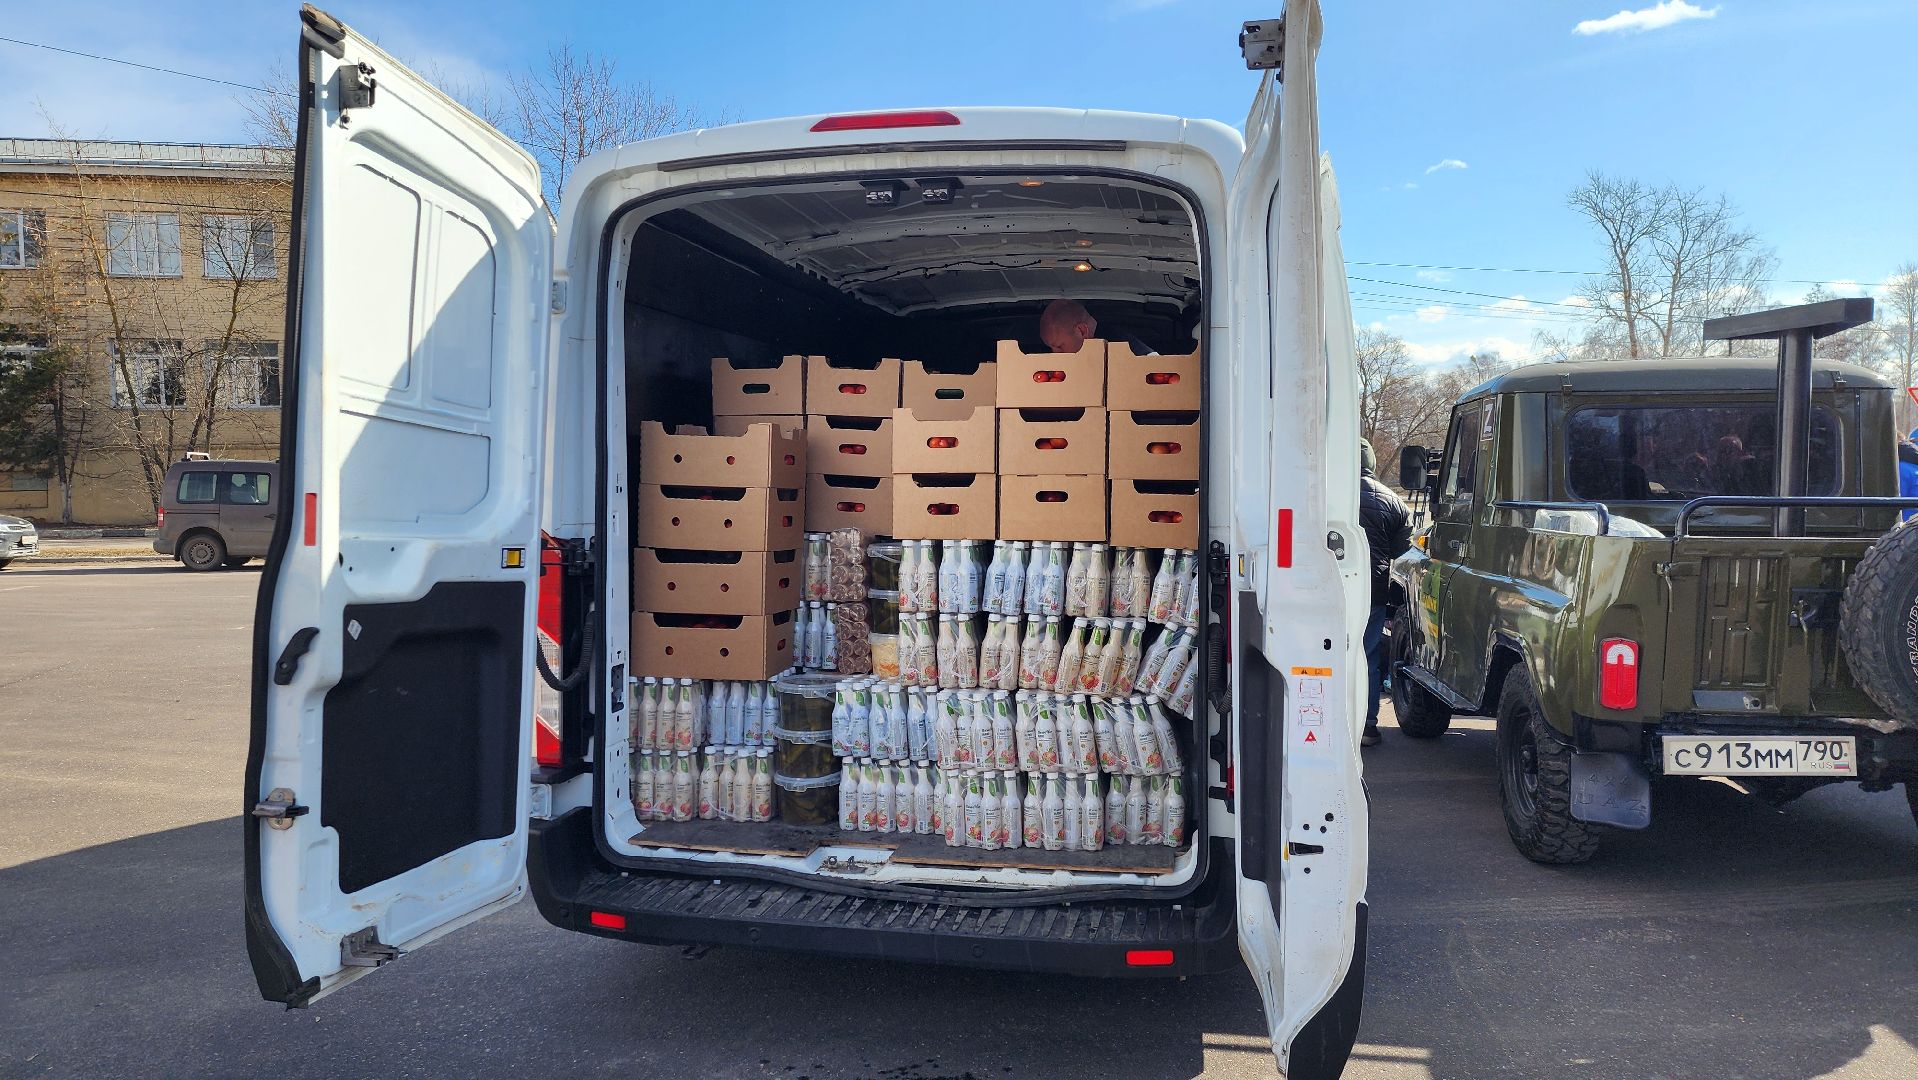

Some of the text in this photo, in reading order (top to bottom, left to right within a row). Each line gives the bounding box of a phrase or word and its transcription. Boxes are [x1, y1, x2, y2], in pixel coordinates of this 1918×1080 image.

[1674, 740, 1843, 769] С913ММ 790
[1810, 761, 1833, 770] RUS
